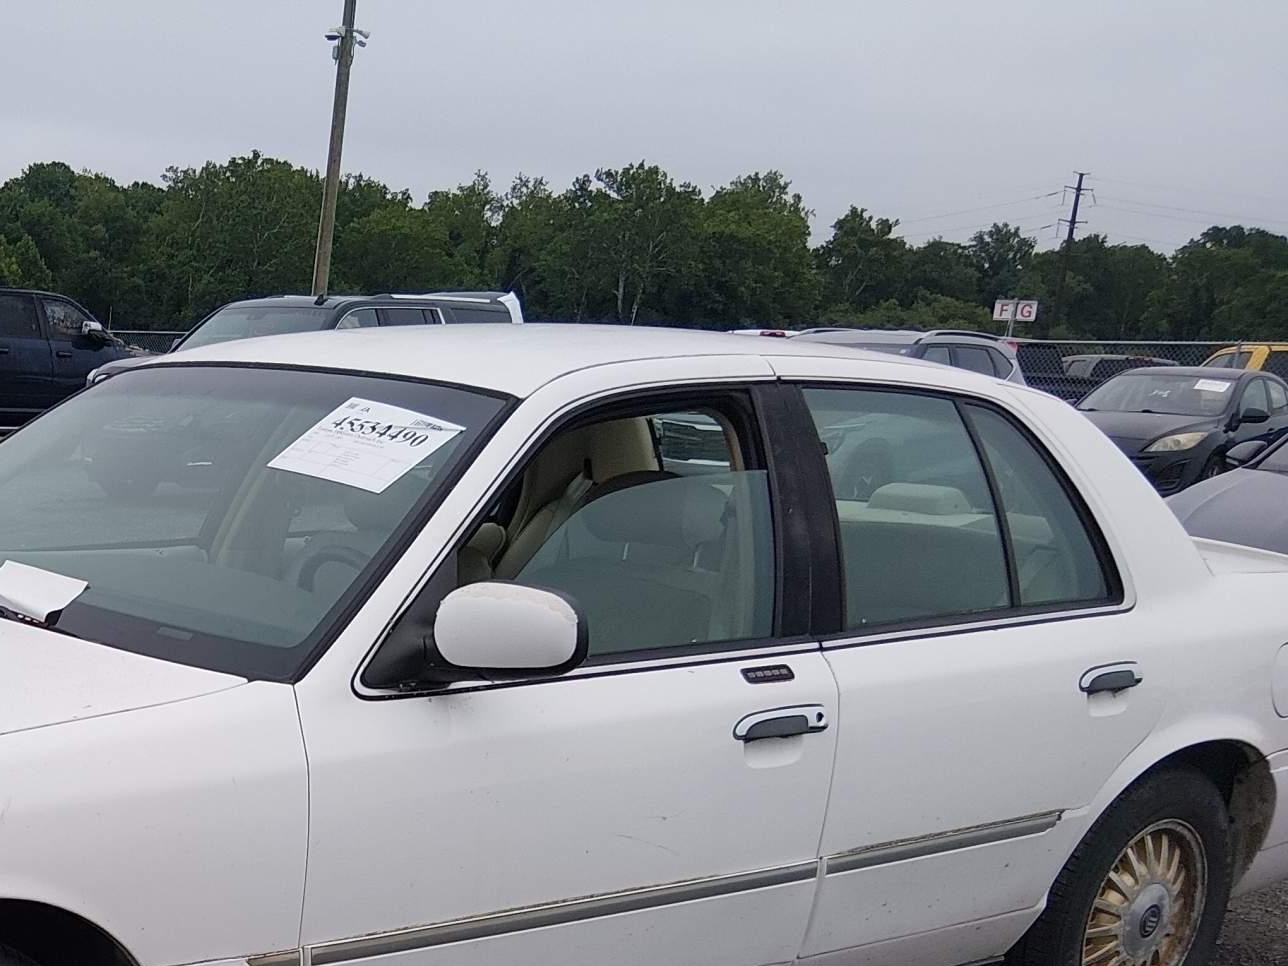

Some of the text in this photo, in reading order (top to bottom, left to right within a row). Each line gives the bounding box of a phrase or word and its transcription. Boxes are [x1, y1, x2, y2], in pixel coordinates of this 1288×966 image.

[999, 304, 1010, 317] F
[1020, 304, 1033, 318] G
[332, 415, 429, 447] 45534490
